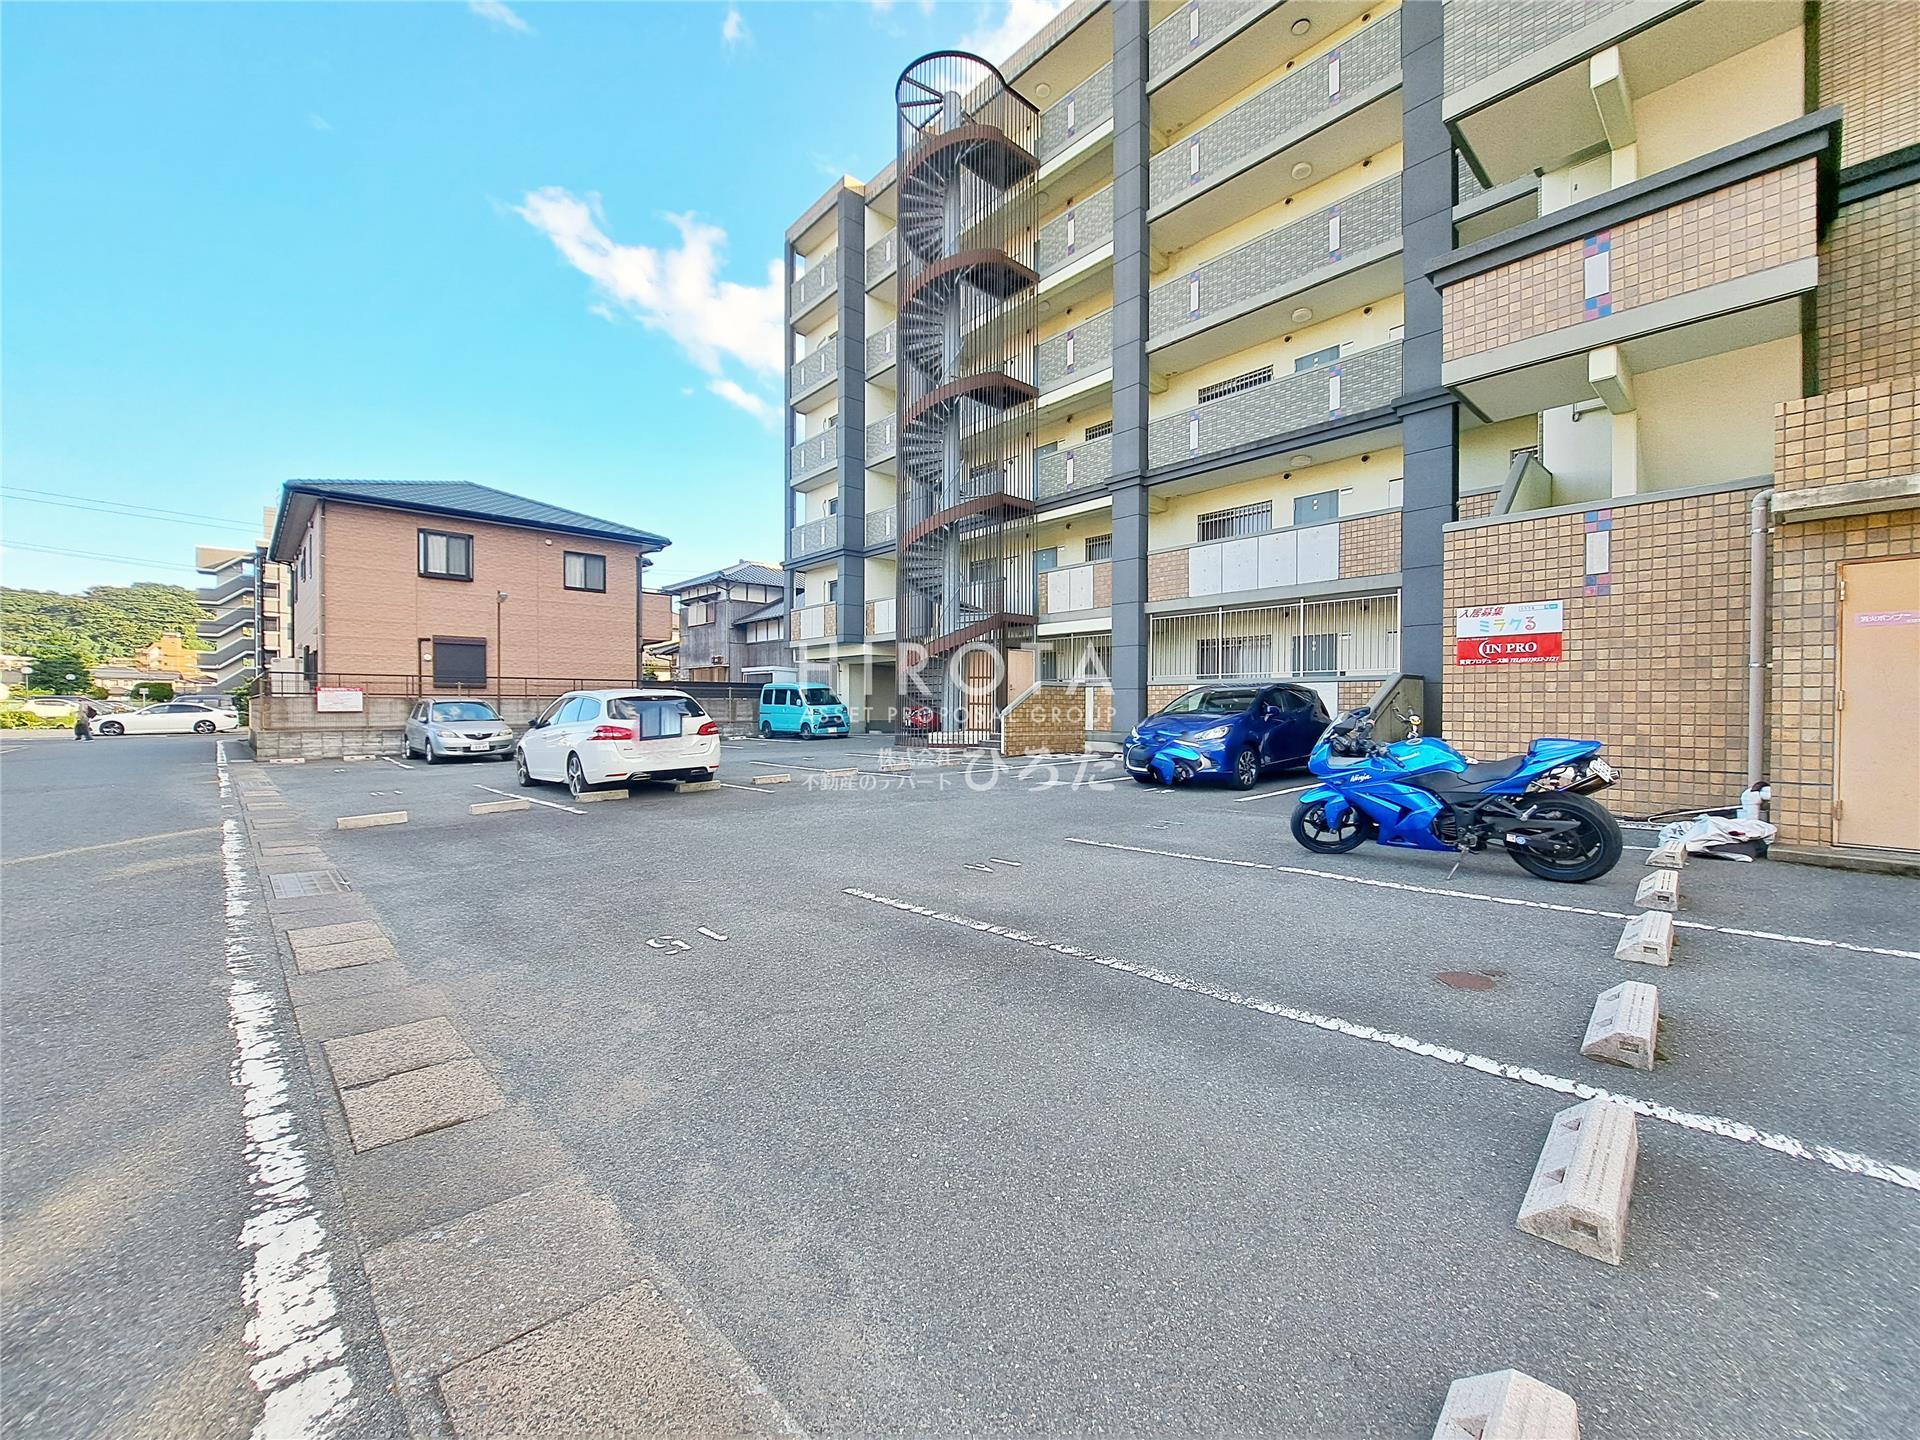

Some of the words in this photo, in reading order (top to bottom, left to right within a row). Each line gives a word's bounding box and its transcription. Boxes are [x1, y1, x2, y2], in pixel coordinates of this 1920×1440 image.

[1459, 607, 1504, 618] 入居募集
[1506, 642, 1538, 653] PRO
